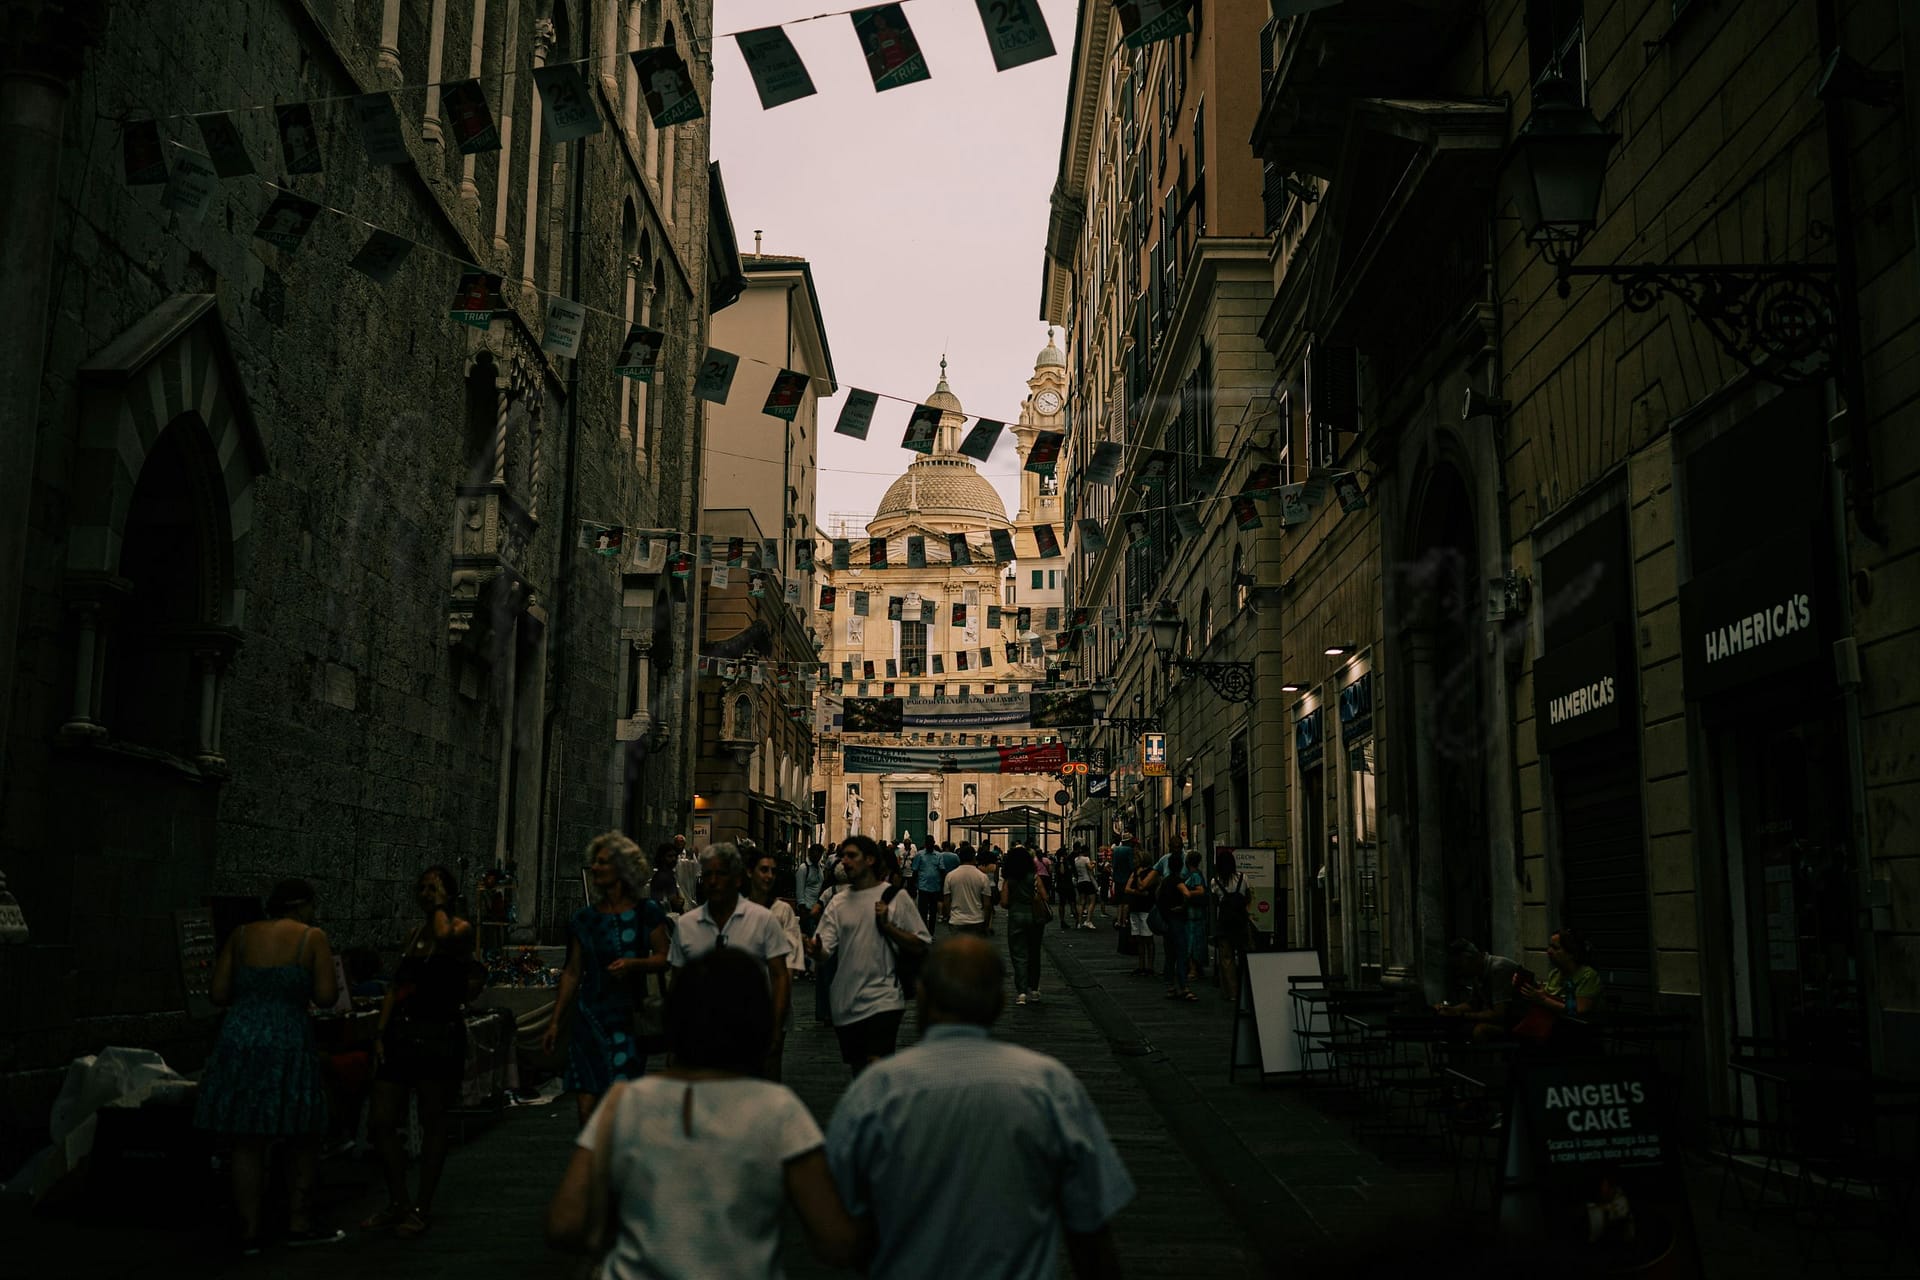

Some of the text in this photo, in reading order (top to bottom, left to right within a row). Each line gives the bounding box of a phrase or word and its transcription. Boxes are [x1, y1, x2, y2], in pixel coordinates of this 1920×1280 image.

[990, 0, 1030, 33] 24
[1140, 9, 1184, 42] GALAN
[891, 56, 922, 83] TRIAY
[547, 80, 582, 110] 24
[663, 96, 699, 123] GALAN
[462, 312, 490, 321] TRIAY
[622, 367, 651, 376] GALAN
[707, 361, 728, 385] 24
[1705, 594, 1811, 664] HAMERICA'S
[1550, 675, 1615, 726] HAMERICA'S
[1545, 1080, 1646, 1109] ANGEL'S
[1567, 1107, 1632, 1133] CAKE
